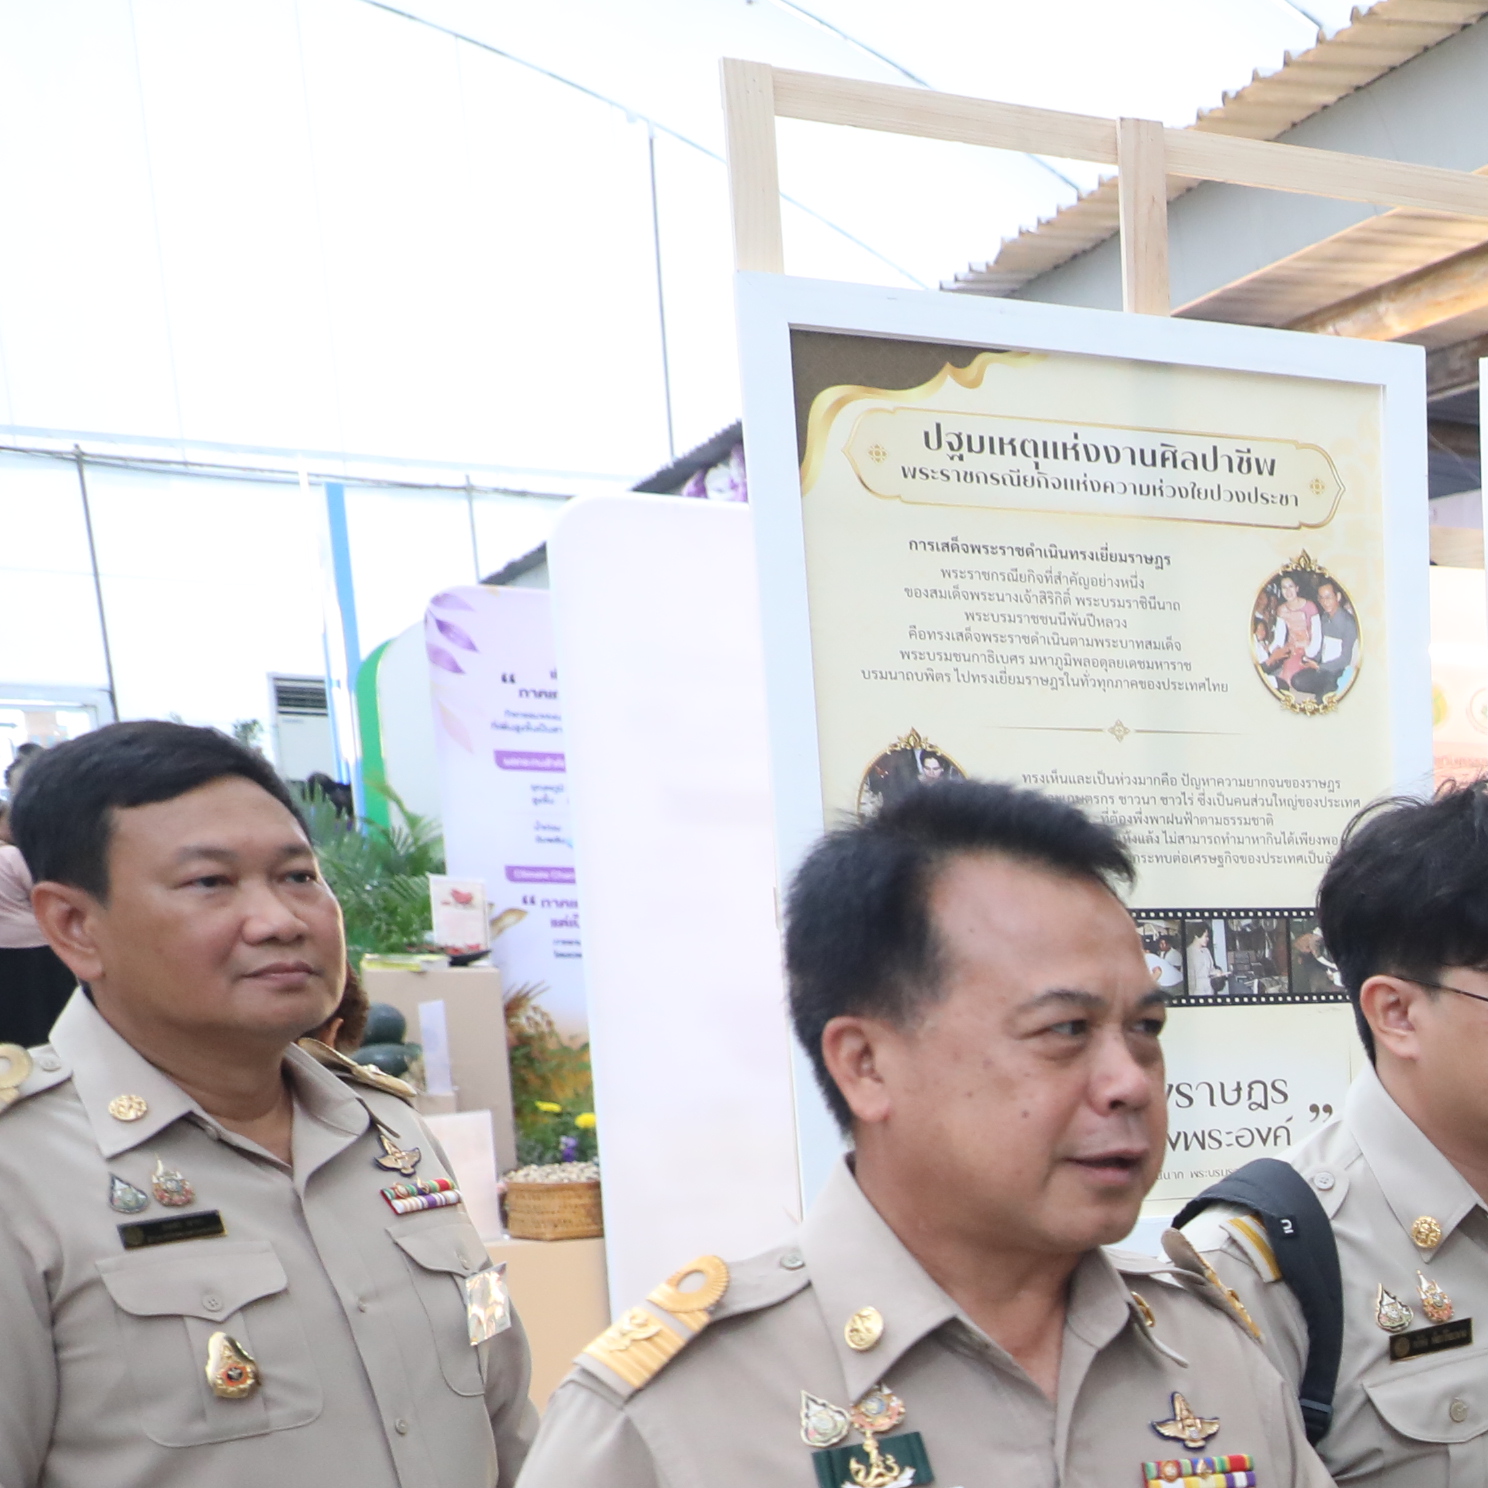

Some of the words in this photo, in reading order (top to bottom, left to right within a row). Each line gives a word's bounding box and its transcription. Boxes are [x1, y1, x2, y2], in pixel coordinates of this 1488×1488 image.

[922, 422, 1277, 478] ปฐมเหตุแห่งงานศิลปาชีพ
[901, 464, 1300, 508] พระราชกรณียกิจแห่งความห่วงใยปวงประชา
[909, 535, 1171, 570] การเสด็จพระราชดำเนินทรงเยี่ยมราษฎร
[941, 566, 1145, 590] พระราชกรณียกิจที่สำคัญอย่างหนึ่ง
[904, 585, 1072, 607] ของสมเด็จพระนางเจ้าสิริกิติ์
[1075, 593, 1181, 612] พระบรมราชินีนาถ
[964, 609, 1128, 630] พระบรมราชชนนีพันปีหลวง
[908, 625, 1182, 652] คือทรงเสด็จพระราชดำเนินตามพระบาทสมเด็จ
[900, 648, 1025, 666] พระบรมชนกาธิเบศร
[1029, 653, 1192, 672] มหาภูมิพลอดุลยเดชมหาราช
[861, 667, 951, 684] บรมนาถบพิตร
[955, 667, 1229, 695] ไปทรงเยี่ยมราษฎรในทั่วทุกภาคของประเทศไทย
[1022, 771, 1177, 789] ทรงเห็นและเป็นห่วงมากคือ
[1181, 773, 1341, 793] ปัญหาความยากจนของราษฎร
[1119, 793, 1157, 806] ชาวนา
[1161, 791, 1194, 806] ชาวไร่
[1197, 790, 1361, 811] ซึ่งเป็นคนส่วนใหญ่ของประเทศ
[1163, 829, 1339, 847] ไม่สามารถทำมาหากินได้เพียงพอ
